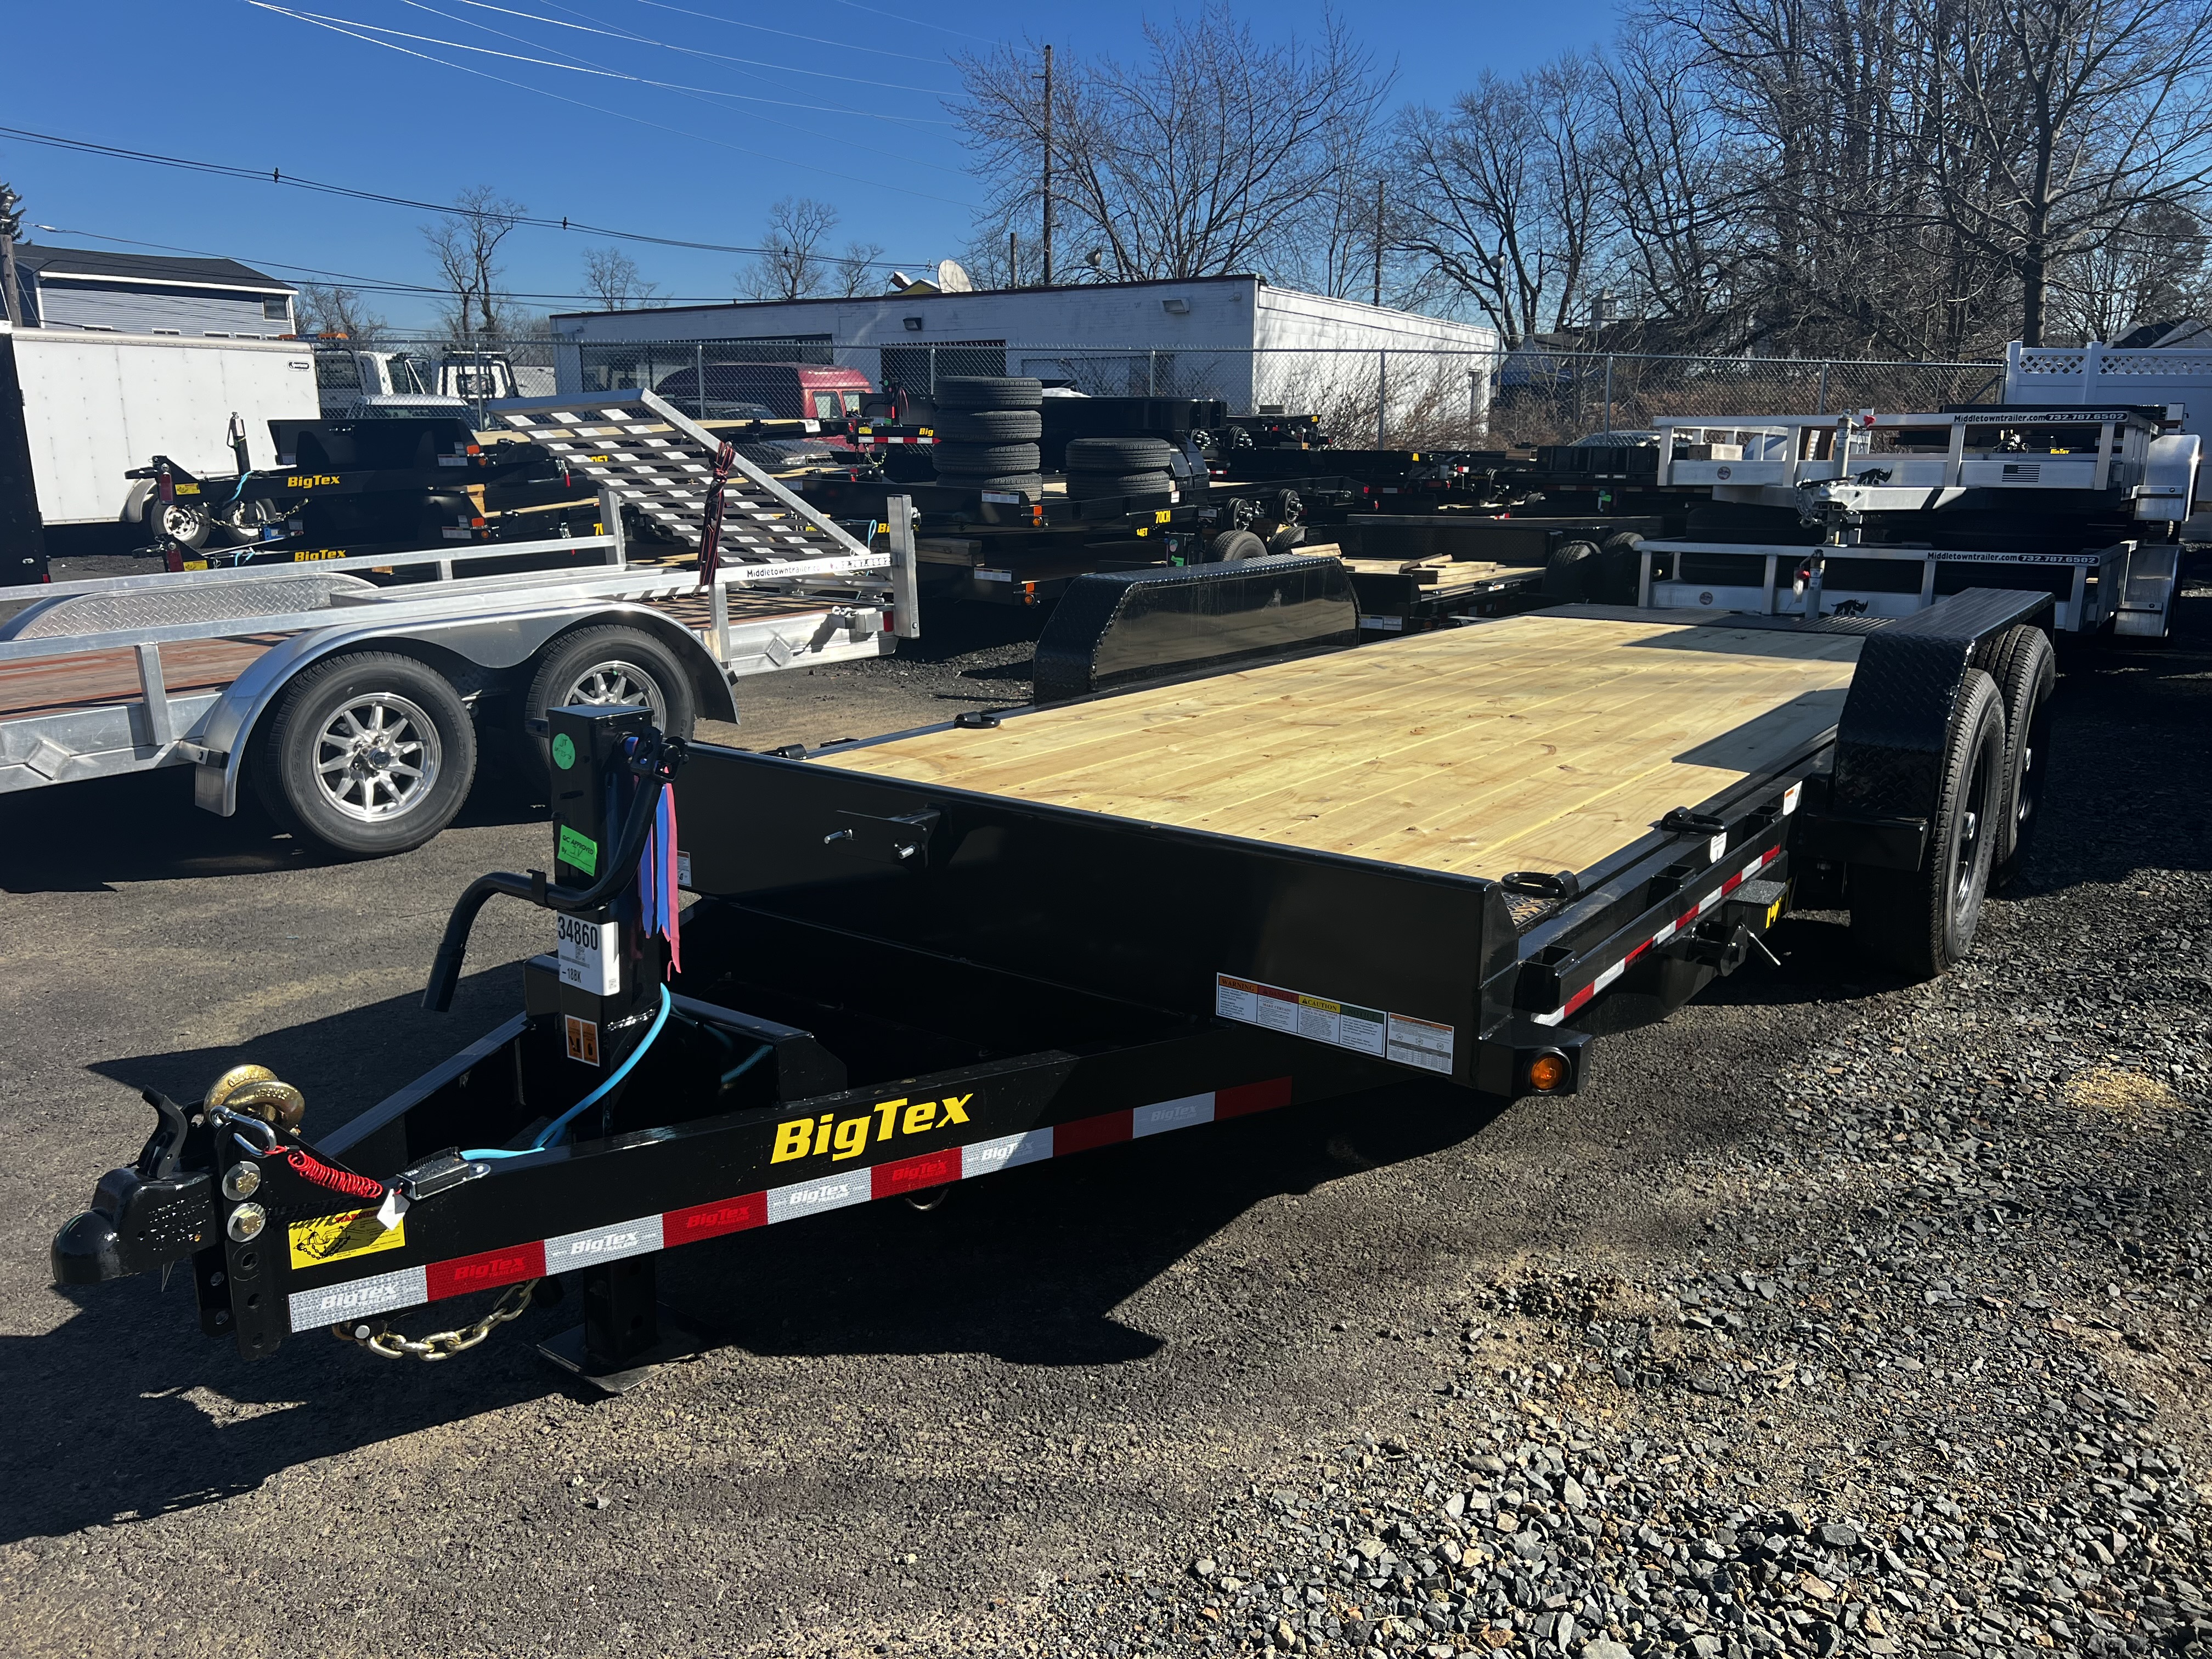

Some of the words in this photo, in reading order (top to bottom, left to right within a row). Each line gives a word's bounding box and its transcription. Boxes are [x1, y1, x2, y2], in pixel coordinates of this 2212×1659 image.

[1954, 414, 2045, 422] Middletowntrailer.com
[287, 475, 341, 489] BigTex
[1155, 510, 1171, 524] 70CH
[294, 549, 348, 562] BigTex
[1927, 552, 2018, 561] Middletowntrailer.com
[2021, 555, 2096, 564] 732.787.6502
[747, 566, 826, 578] Middletowntrailer.co
[557, 916, 599, 951] 34860
[1222, 978, 1255, 992] WARNING
[1307, 998, 1338, 1011] CAUTION
[1150, 1105, 1198, 1122] BigTex
[770, 1093, 974, 1165] BigTex
[981, 1141, 1034, 1161] BigTex
[892, 1160, 949, 1182] BigTex
[789, 1183, 851, 1205] BigTex
[686, 1206, 751, 1229] BigTex
[571, 1231, 639, 1255] BigTex
[603, 1240, 639, 1253] TRAILERS
[454, 1256, 527, 1281] BigTex
[488, 1266, 526, 1278] TRAILERS
[320, 1284, 399, 1311] BigTex
